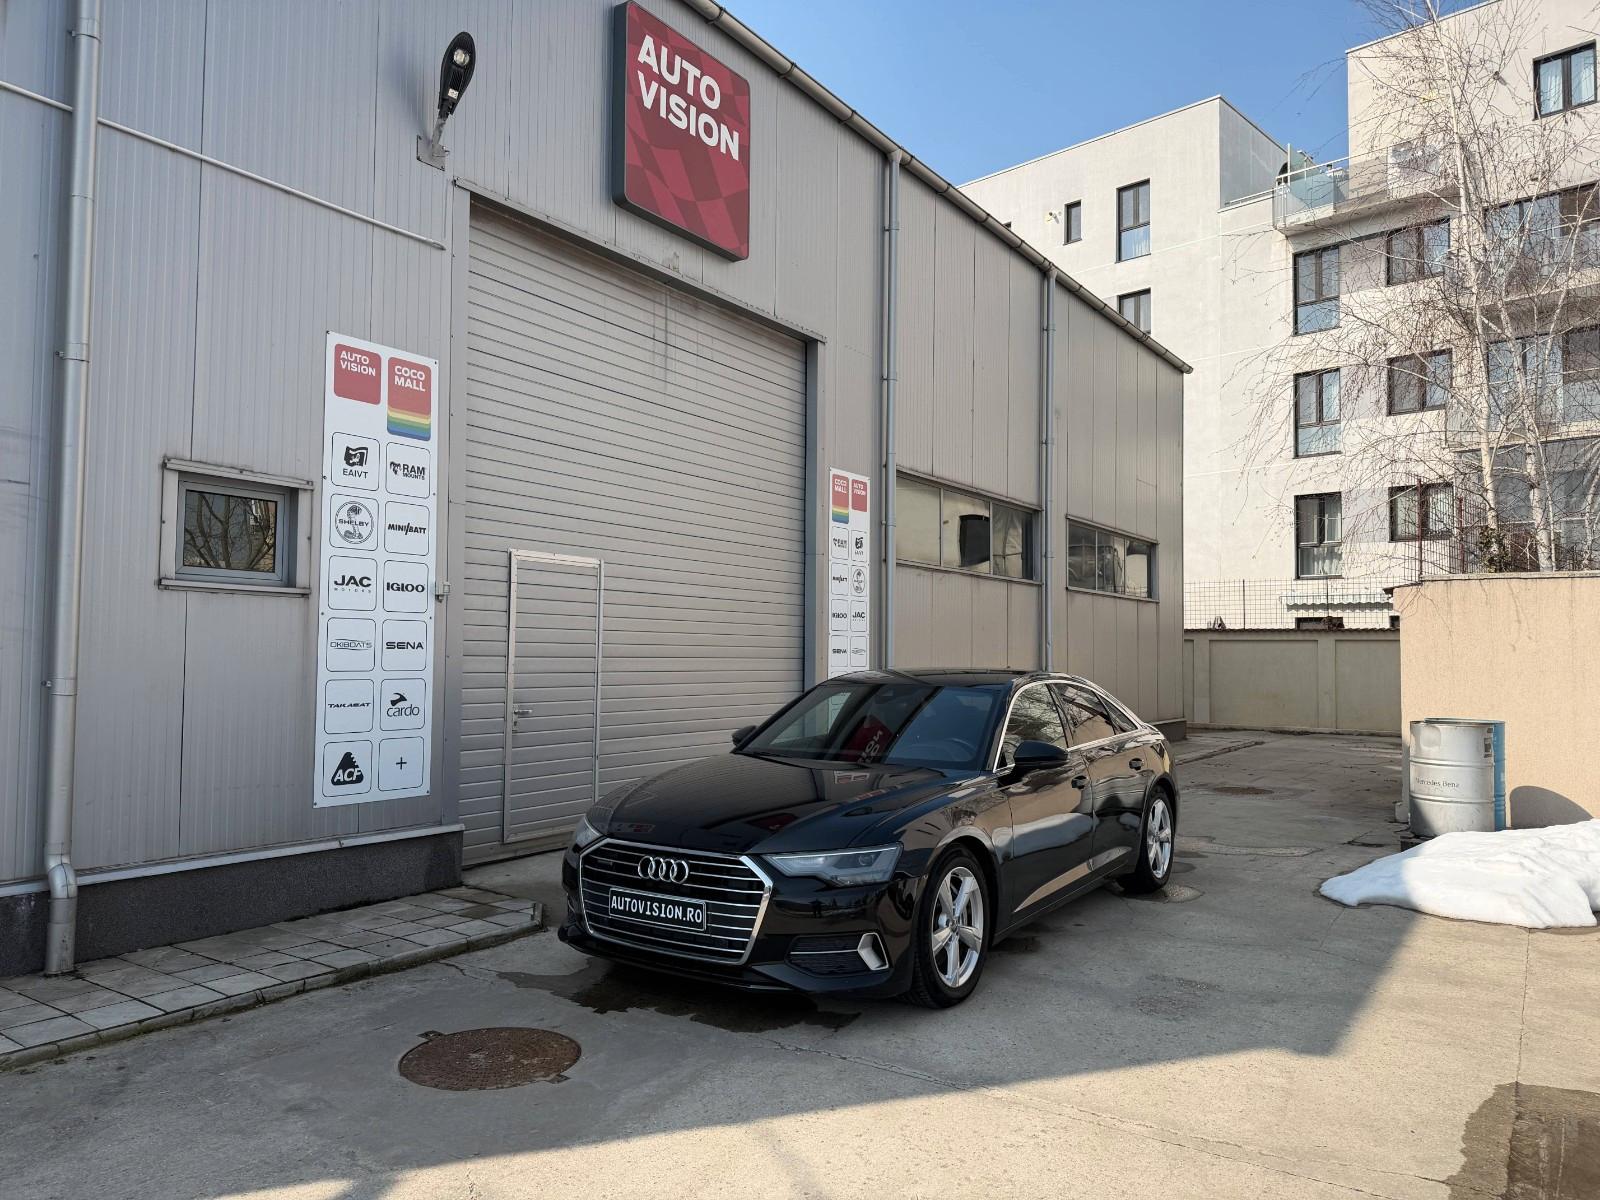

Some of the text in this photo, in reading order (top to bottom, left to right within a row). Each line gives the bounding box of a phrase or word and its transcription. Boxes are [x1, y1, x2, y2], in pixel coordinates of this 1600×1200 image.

[637, 34, 721, 110] AUTO
[637, 70, 739, 161] VISION
[340, 350, 370, 365] AUTO
[340, 359, 376, 377] VISION
[394, 365, 426, 381] COCO
[394, 375, 426, 392] MALL
[402, 463, 426, 476] RAM
[338, 518, 369, 527] SHELBY
[333, 574, 372, 588] JAC
[852, 611, 866, 619] JAC
[385, 641, 424, 650] SENA
[386, 703, 420, 718] cardo
[611, 895, 703, 923] AUTOVISION.RO
